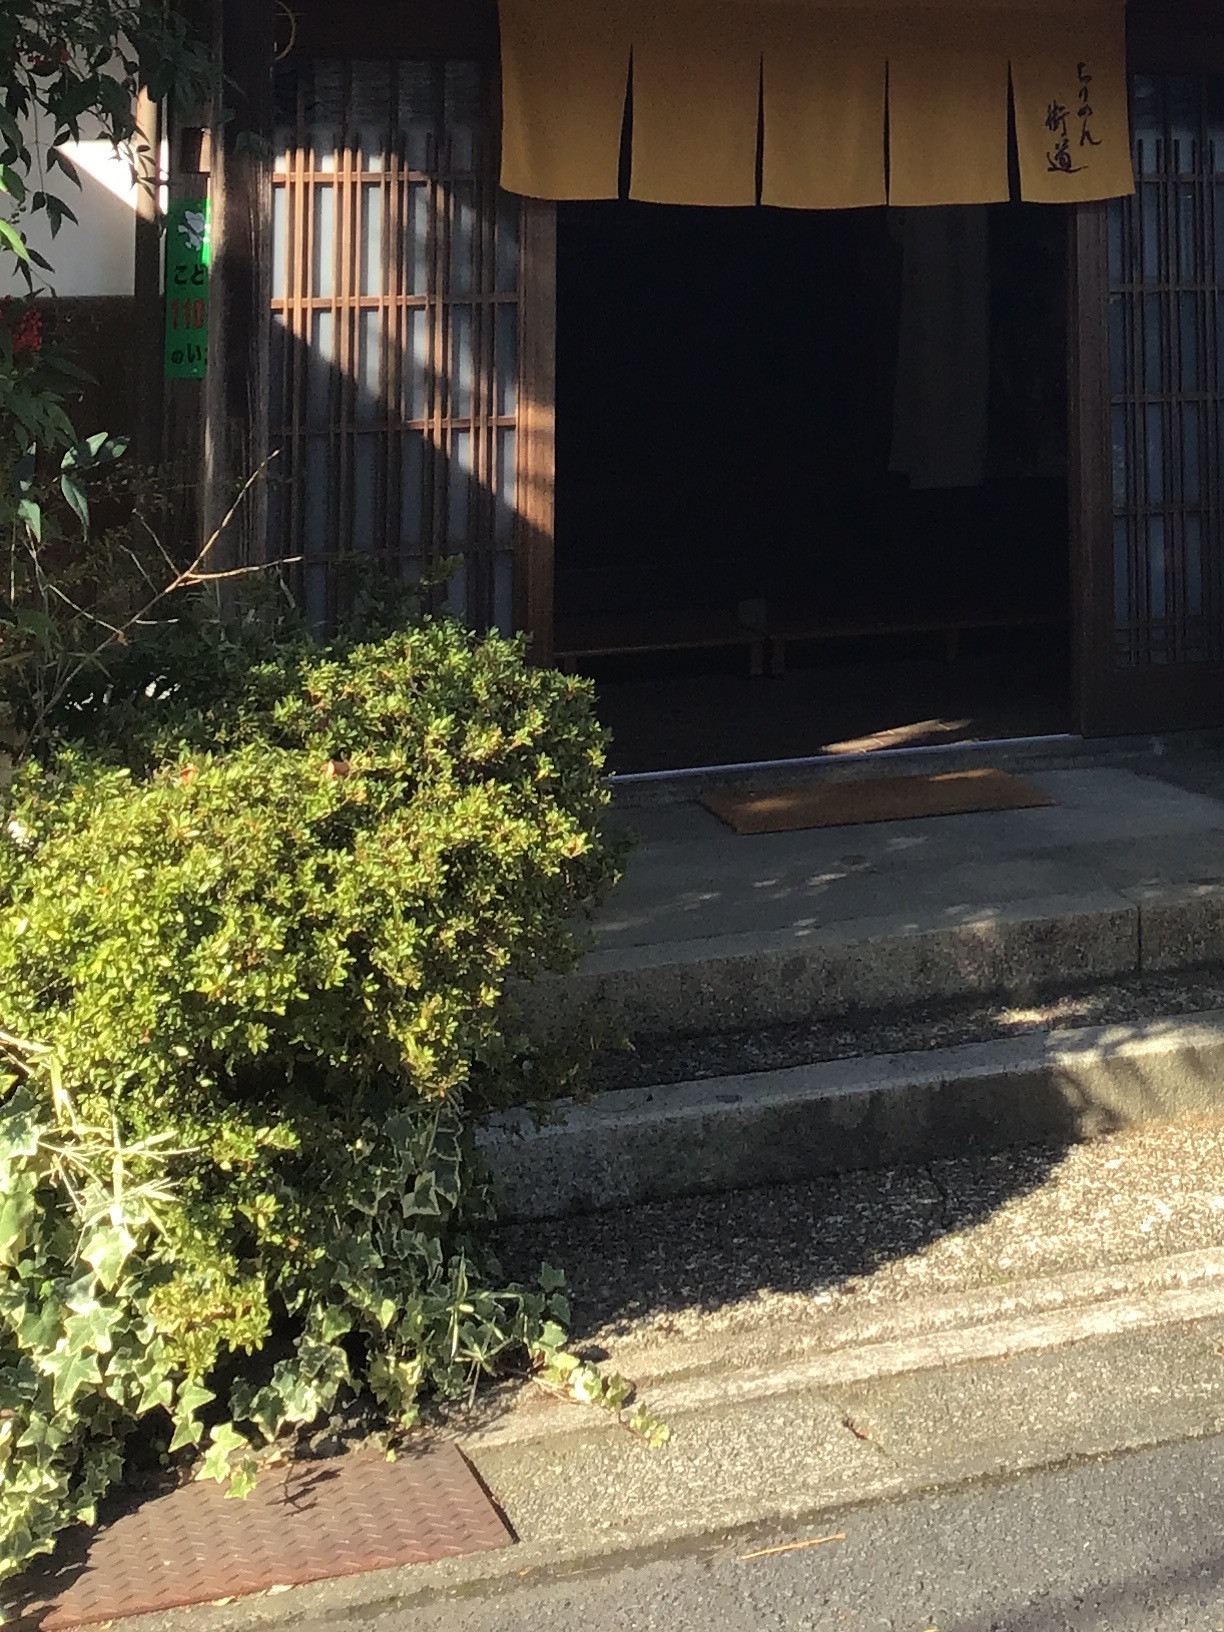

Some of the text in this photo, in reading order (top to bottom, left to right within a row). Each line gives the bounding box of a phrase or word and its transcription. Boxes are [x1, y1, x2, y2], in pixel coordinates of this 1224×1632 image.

[1076, 61, 1103, 146] ちりめん
[1045, 99, 1089, 174] 街道
[172, 298, 206, 331] 110
[171, 342, 208, 365] のい
